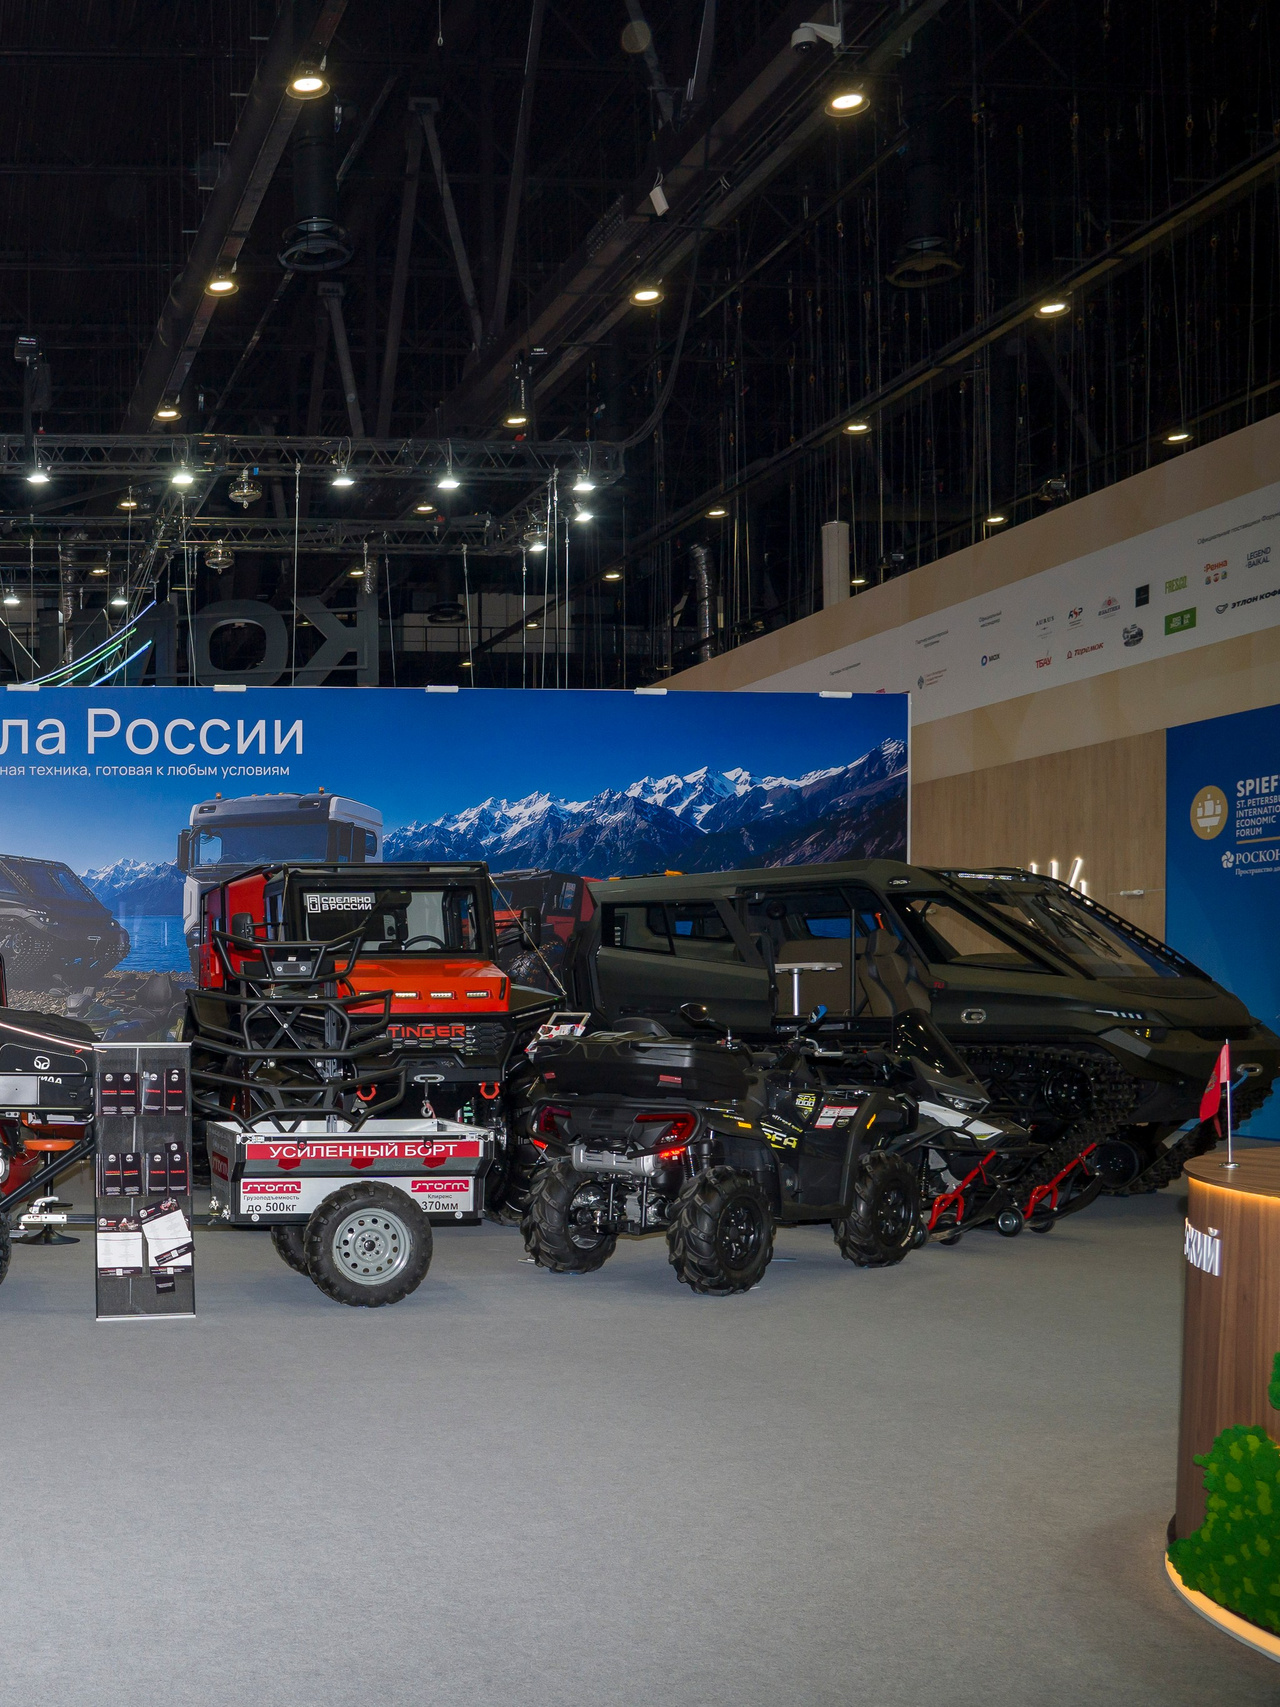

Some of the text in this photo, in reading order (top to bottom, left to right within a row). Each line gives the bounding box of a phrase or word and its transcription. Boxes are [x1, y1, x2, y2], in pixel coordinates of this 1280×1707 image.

[1035, 616, 1055, 627] AURUS
[1035, 656, 1052, 669] ТБАУ
[87, 708, 303, 755] России
[29, 766, 91, 777] техника,
[95, 766, 152, 776] готовая
[156, 766, 164, 775] к
[167, 764, 217, 775] любым
[221, 766, 290, 779] условиям
[1236, 815, 1276, 828] ECONOMIC
[1236, 827, 1262, 837] FORUM
[322, 896, 371, 904] СДЕЛАНО
[388, 1025, 465, 1038] TINGER
[269, 1142, 458, 1158] УСИЛЕННЫЙ БОРТ
[247, 1202, 297, 1213] до 500кг
[421, 1201, 459, 1211] 370мм
